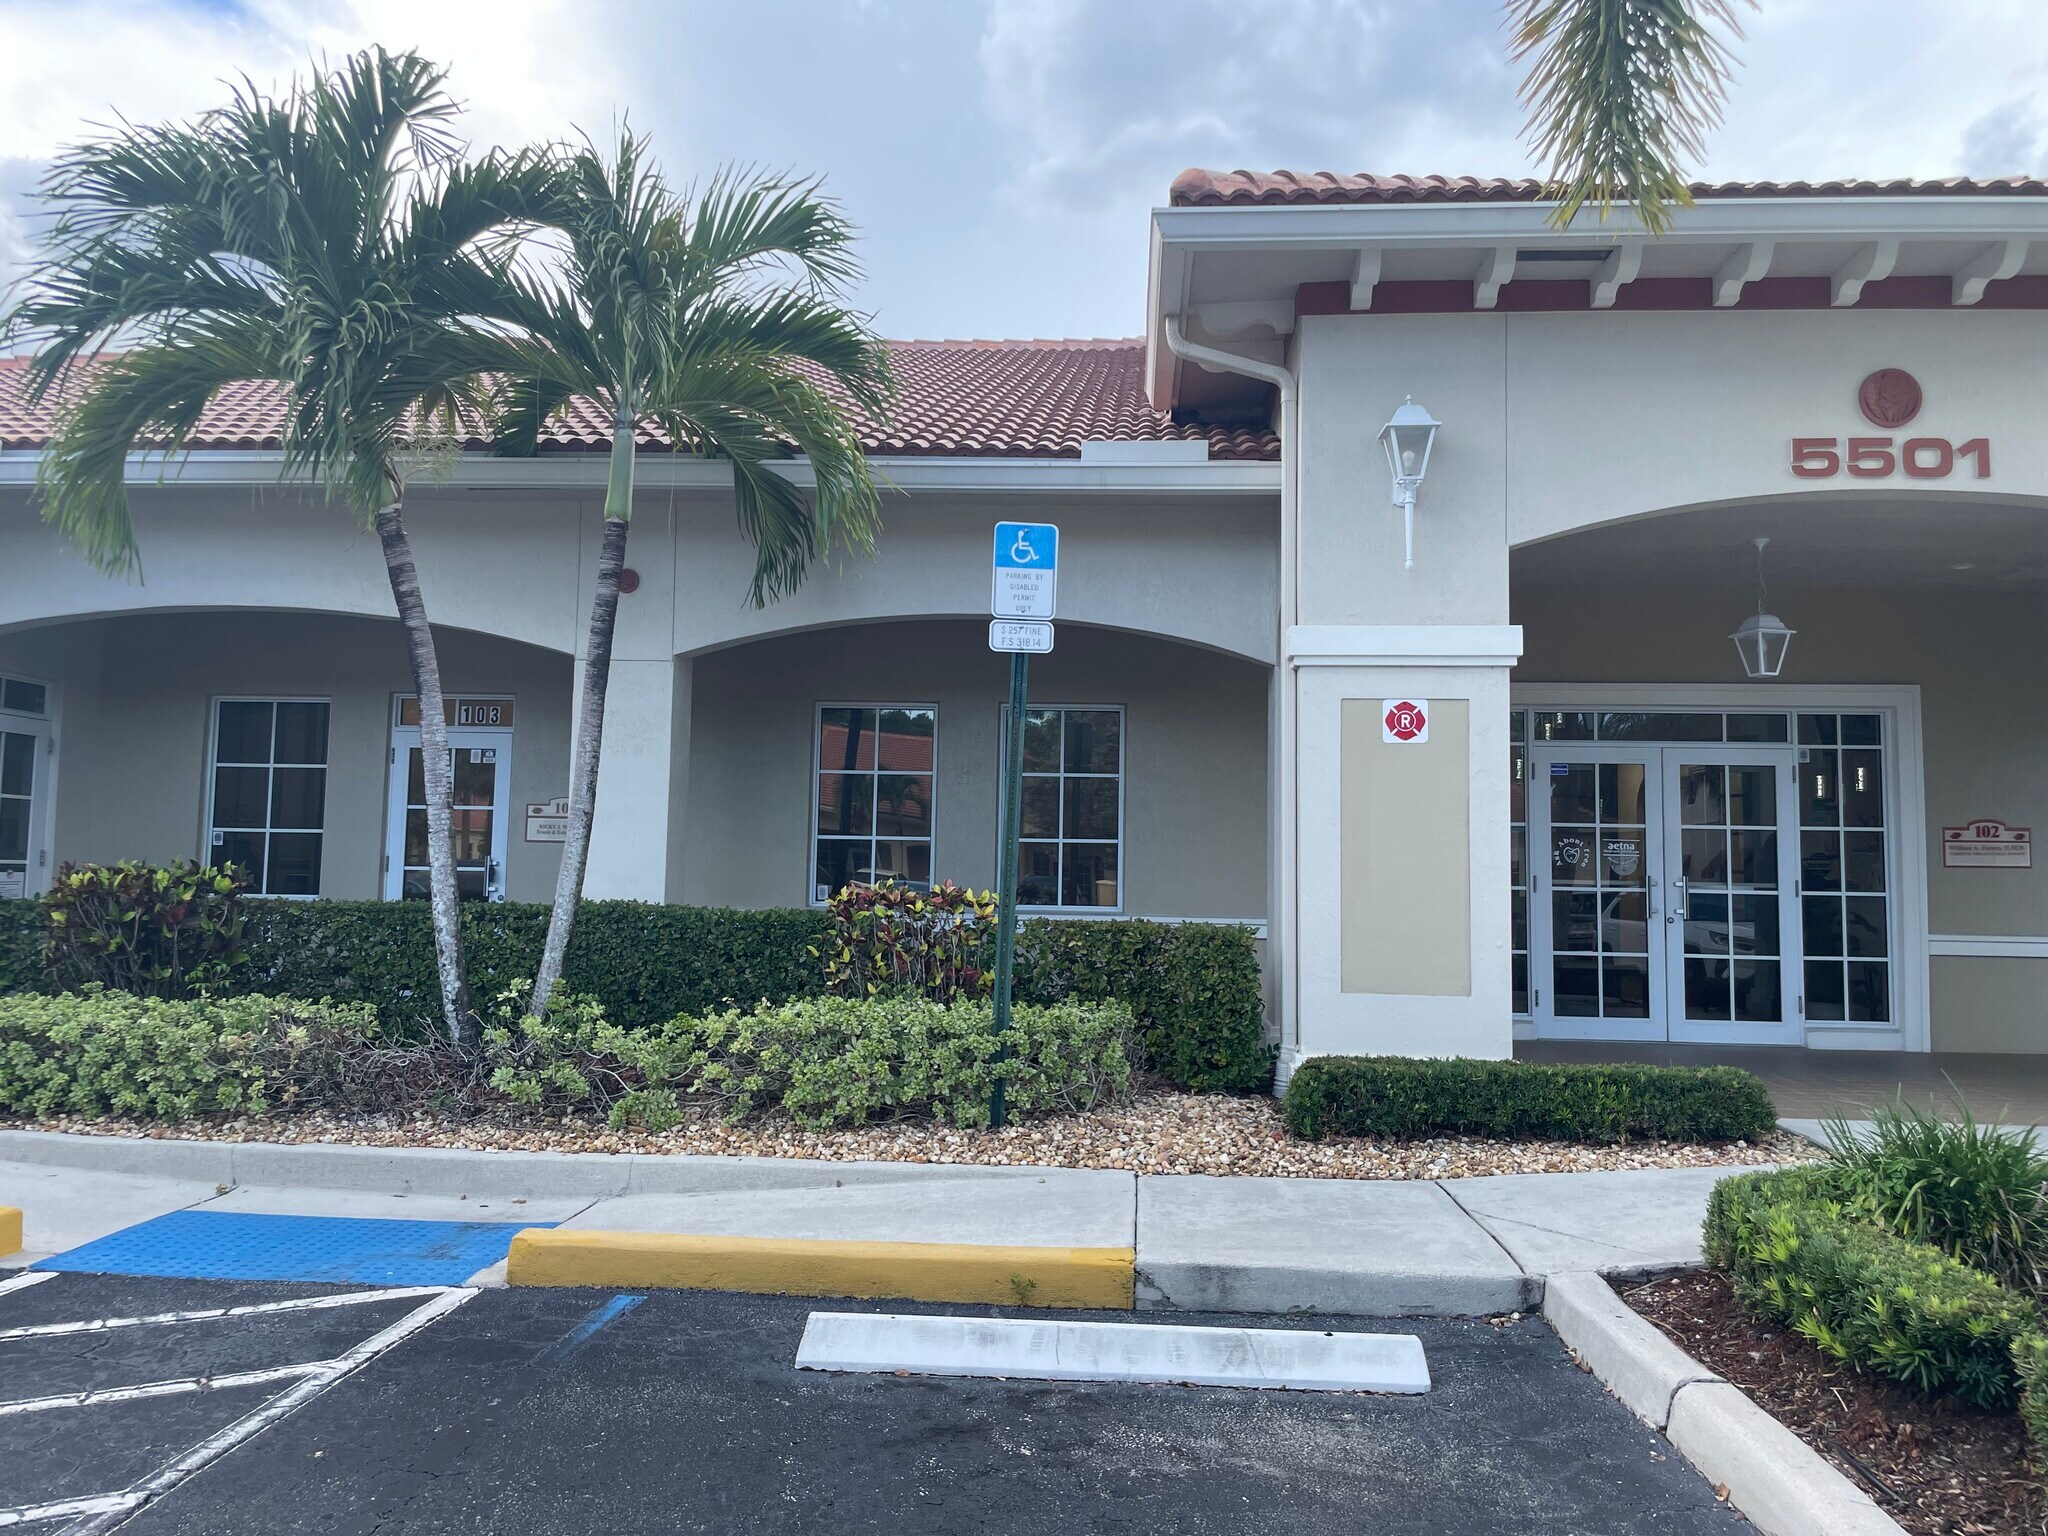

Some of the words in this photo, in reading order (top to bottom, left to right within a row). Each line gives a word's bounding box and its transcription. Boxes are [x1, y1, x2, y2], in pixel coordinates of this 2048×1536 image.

[1790, 438, 1990, 479] 5501
[1005, 572, 1031, 580] PARKING
[1009, 583, 1039, 591] DISABLED
[1025, 627, 1042, 636] FINE
[1016, 637, 1041, 647] 318.14
[462, 705, 500, 723] 103
[1401, 714, 1411, 728] R
[1974, 825, 2000, 838] 102
[1607, 842, 1635, 850] aetna
[1553, 850, 1563, 866] Ask
[1558, 838, 1584, 847] About
